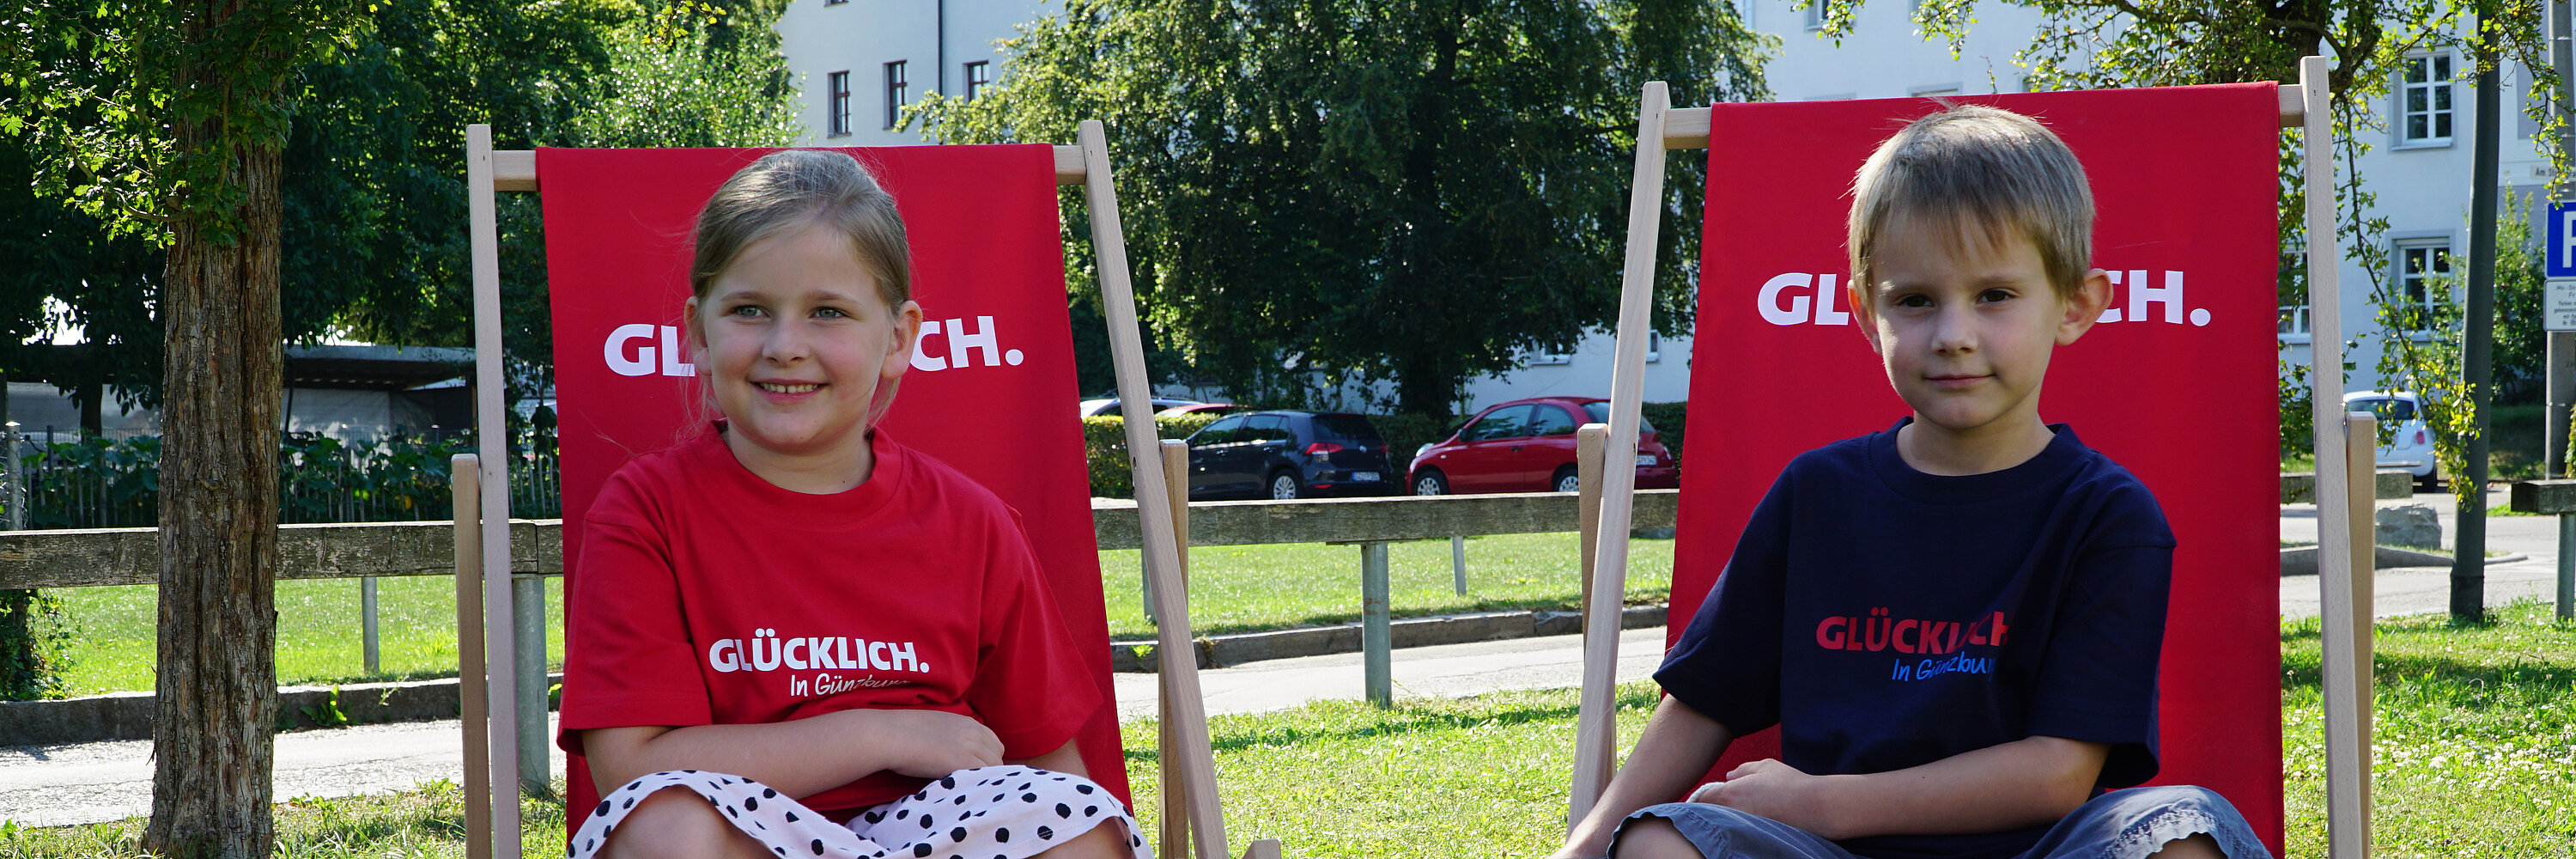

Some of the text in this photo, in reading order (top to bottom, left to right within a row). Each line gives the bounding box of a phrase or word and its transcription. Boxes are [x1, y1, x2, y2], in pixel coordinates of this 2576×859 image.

[708, 628, 930, 673] GLÜCKLICH.
[1892, 658, 1911, 682] In
[790, 674, 808, 697] In
